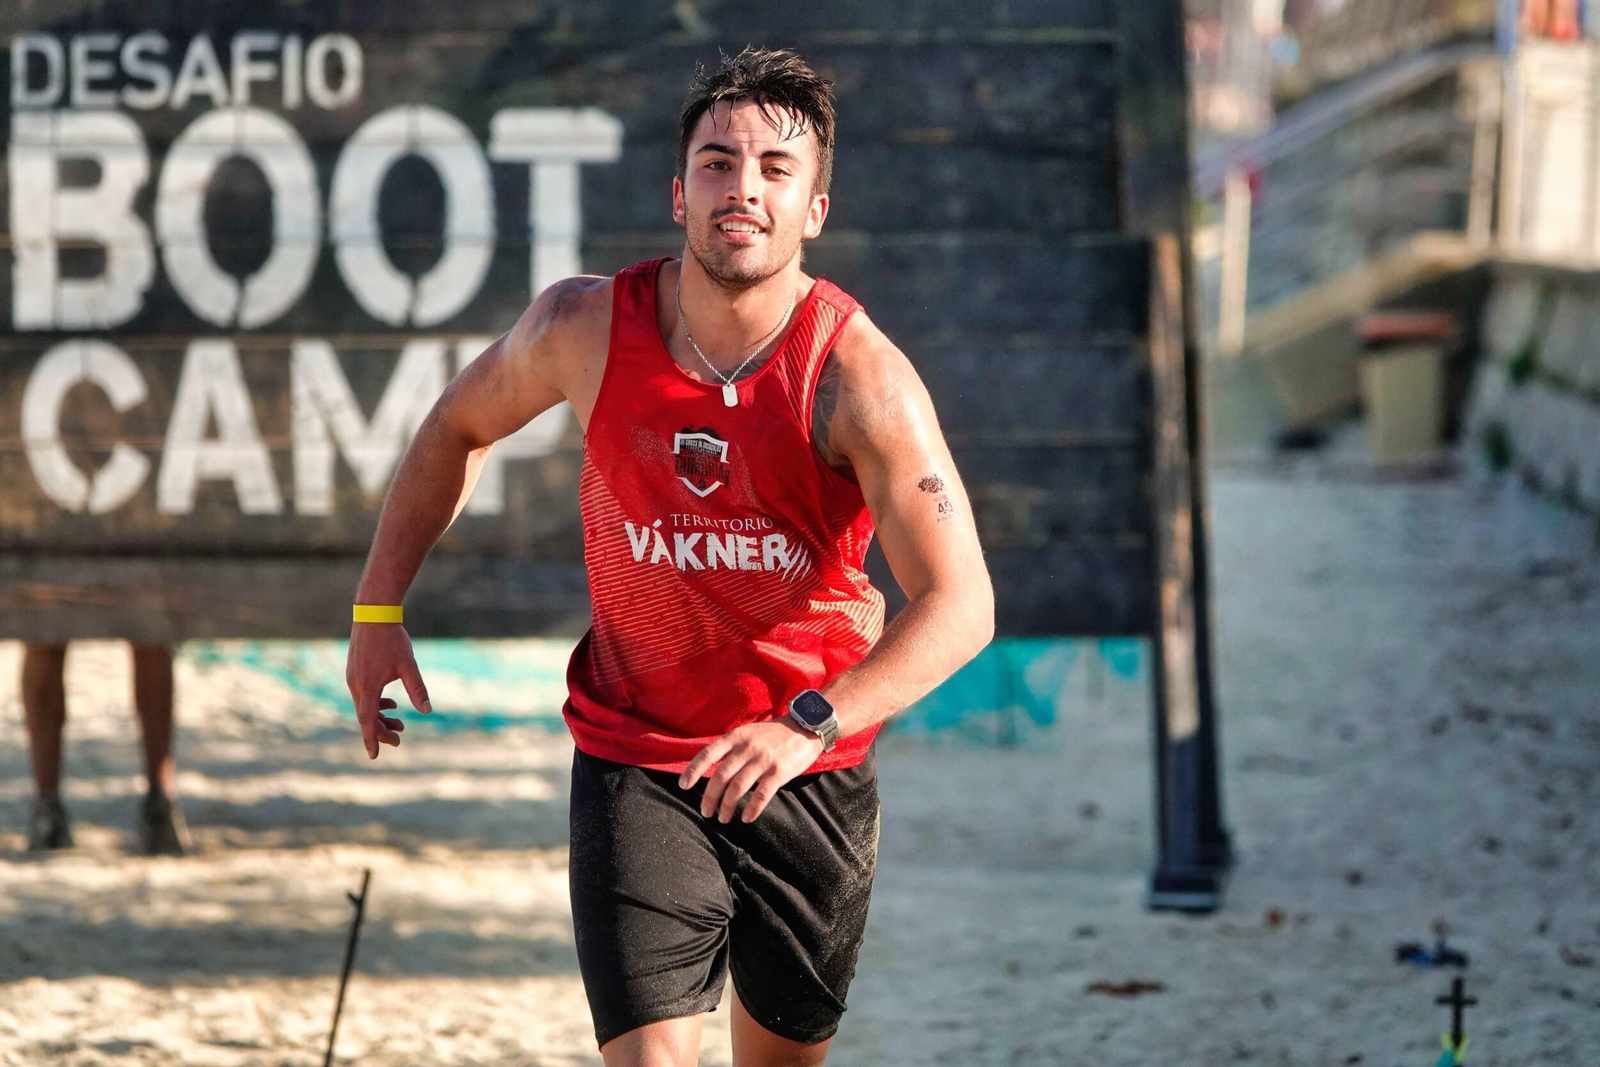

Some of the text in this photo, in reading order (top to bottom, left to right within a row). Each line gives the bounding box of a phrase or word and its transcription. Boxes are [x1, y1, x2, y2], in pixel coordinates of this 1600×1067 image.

[10, 32, 364, 109] DESAFIO
[8, 105, 623, 331] BOOT
[624, 518, 794, 572] VÁKNER
[670, 513, 774, 532] TERRITORIO
